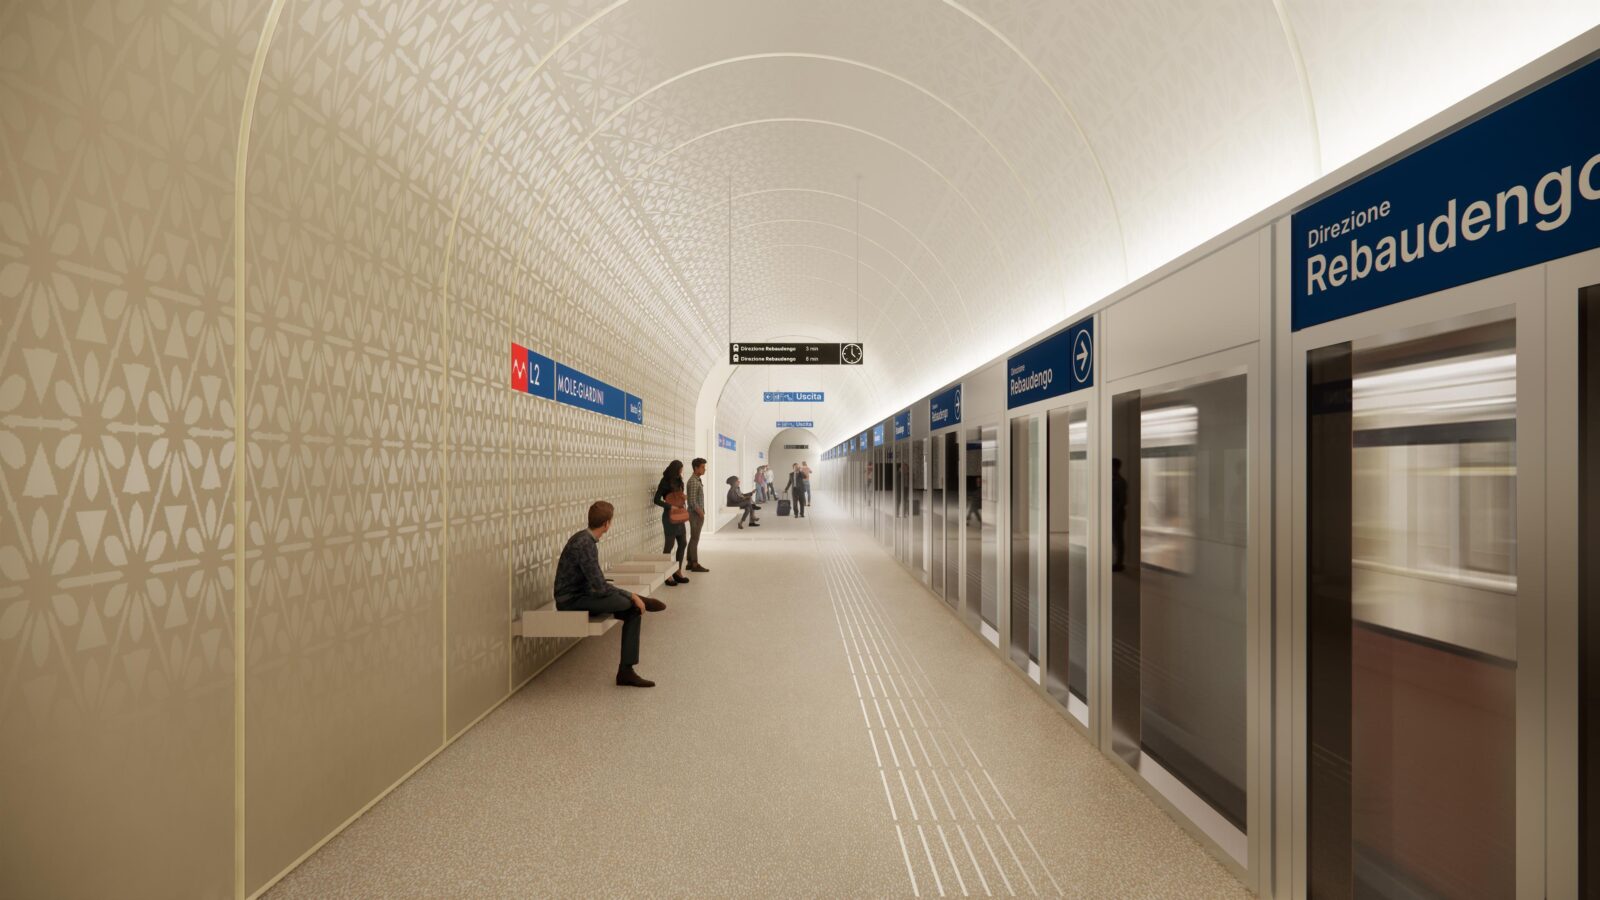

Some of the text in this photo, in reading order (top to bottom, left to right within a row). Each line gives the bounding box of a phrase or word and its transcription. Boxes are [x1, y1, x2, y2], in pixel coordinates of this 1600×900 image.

[1306, 152, 1600, 297] Rebaudengo
[1308, 200, 1391, 249] Direzione
[529, 361, 540, 386] L2
[557, 374, 604, 406] MOLE-GIARDINI
[796, 392, 822, 400] Uscita
[1010, 368, 1053, 396] Rebaudengo
